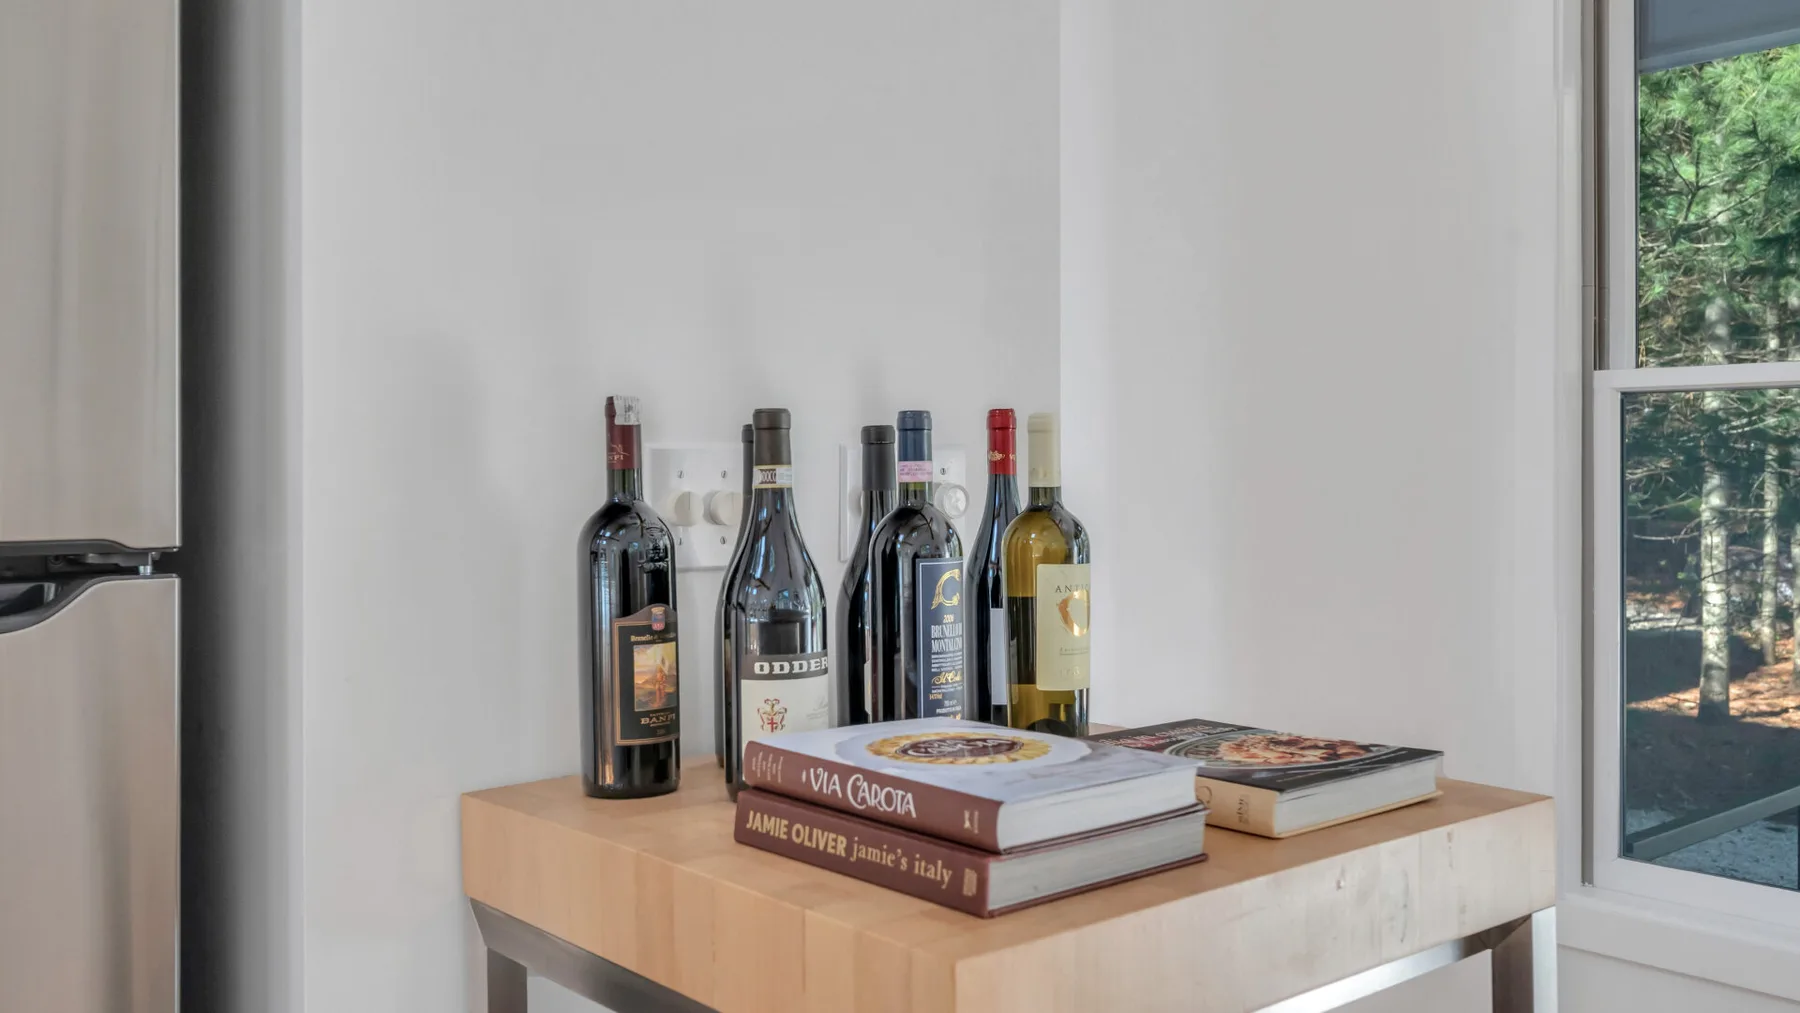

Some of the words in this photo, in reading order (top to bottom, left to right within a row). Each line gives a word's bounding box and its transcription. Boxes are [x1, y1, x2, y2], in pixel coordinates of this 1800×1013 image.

[810, 768, 842, 799] VIA
[847, 774, 916, 818] CAROTA
[746, 810, 789, 840] JAMIE
[792, 823, 847, 857] OLIVER
[850, 837, 908, 872] jamie's
[914, 854, 953, 889] italy
